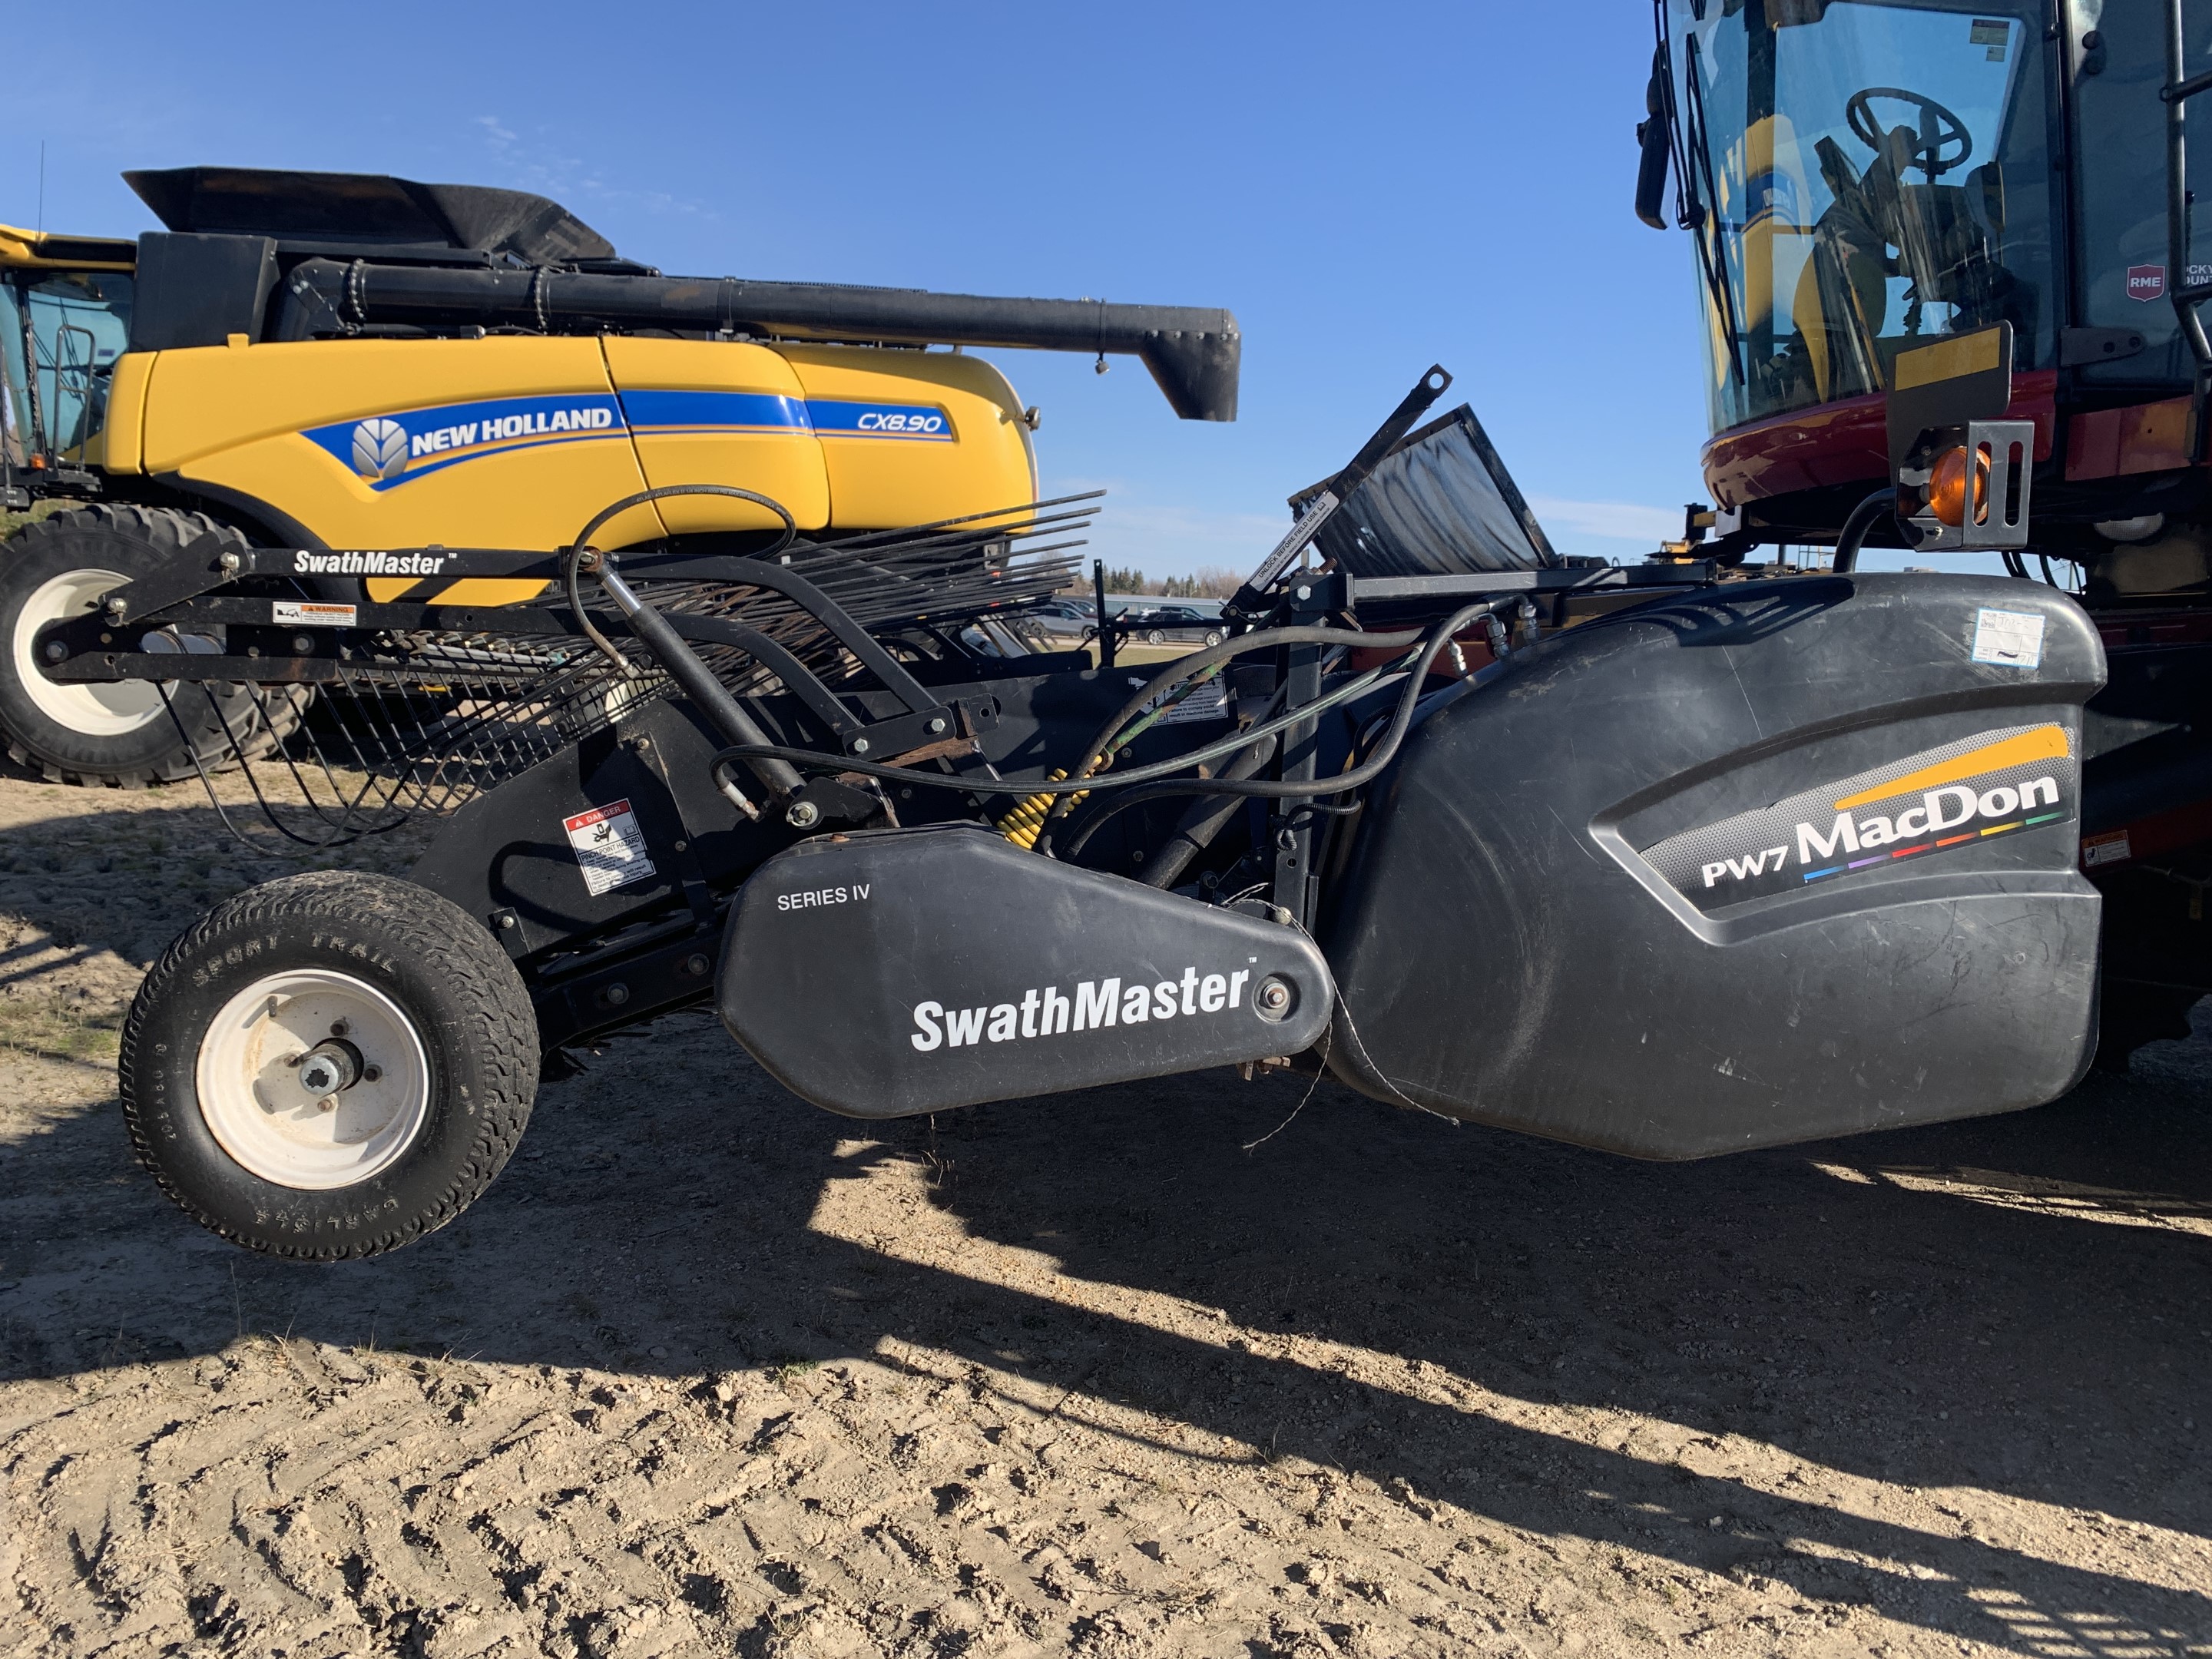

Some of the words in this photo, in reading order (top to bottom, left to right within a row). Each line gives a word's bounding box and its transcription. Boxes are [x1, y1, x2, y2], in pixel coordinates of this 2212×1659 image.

[2130, 276, 2161, 288] RME
[412, 422, 477, 456] NEW
[482, 408, 612, 441] HOLLAND
[857, 413, 942, 432] CX8.90
[1258, 555, 1278, 578] UNLOCK
[1276, 535, 1296, 557] BEFORE
[1293, 521, 1308, 537] FIELD
[1306, 510, 1318, 522] USE
[294, 550, 444, 575] SwathMaster
[586, 805, 621, 823] DANGER
[1702, 846, 1788, 887] PW7
[1796, 777, 2059, 864] MacDon
[581, 849, 598, 861] PINCH
[598, 844, 615, 854] POINT
[615, 835, 640, 849] HAZARD
[777, 887, 848, 911] SERIES
[853, 883, 870, 901] IV
[192, 935, 278, 988] SPORT
[311, 932, 399, 975] TRAIL
[911, 966, 1250, 1052] SwathMaster
